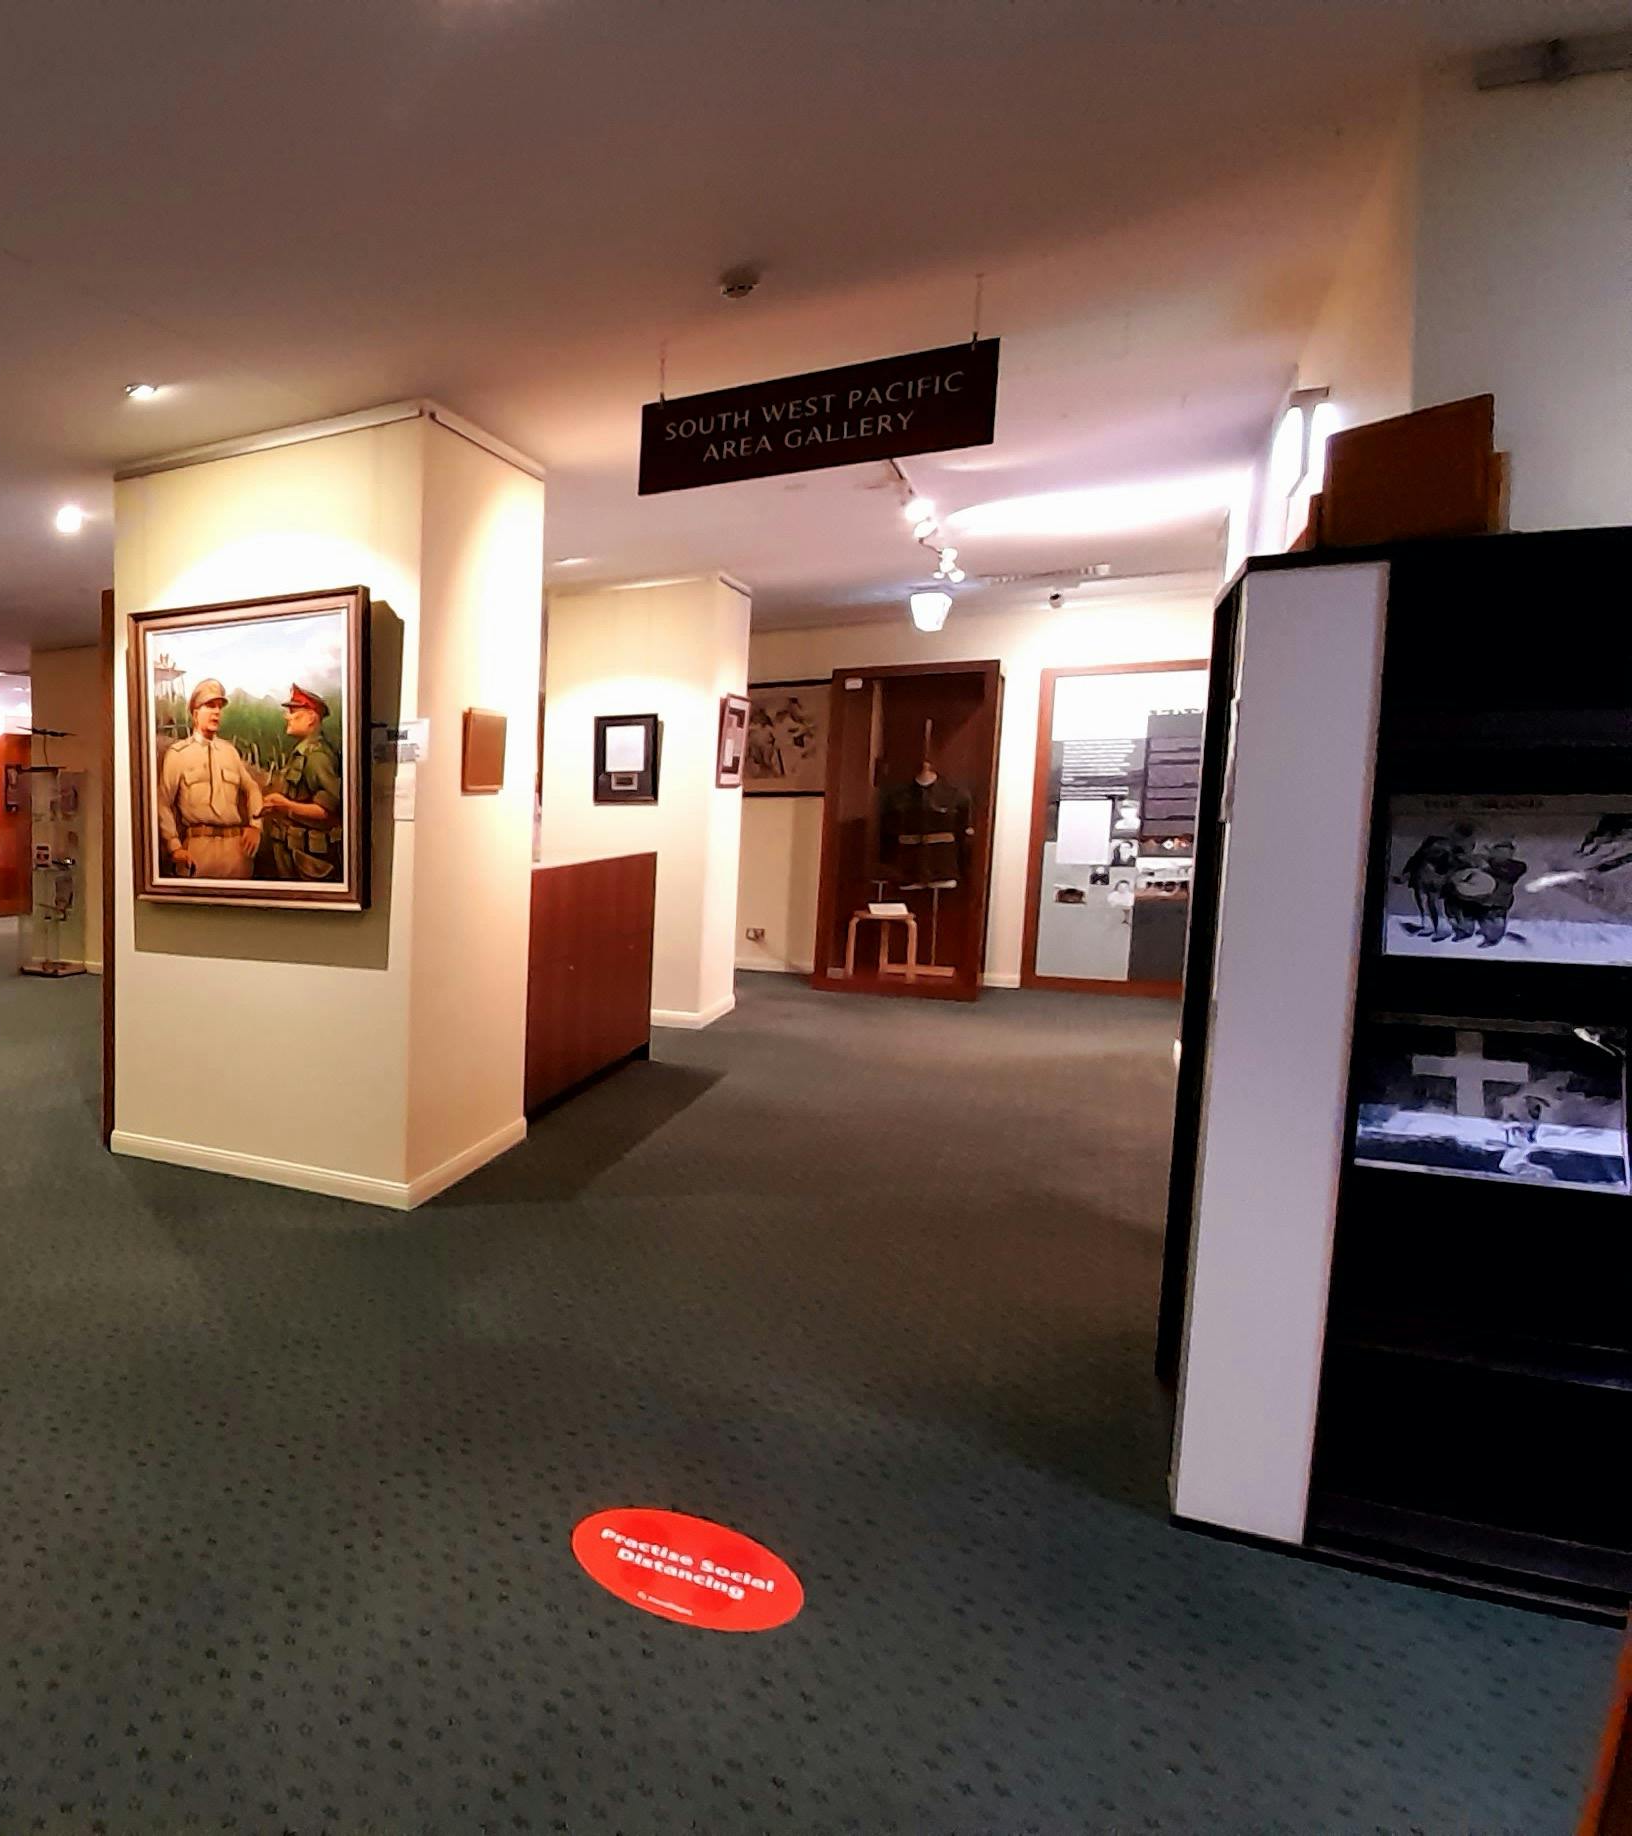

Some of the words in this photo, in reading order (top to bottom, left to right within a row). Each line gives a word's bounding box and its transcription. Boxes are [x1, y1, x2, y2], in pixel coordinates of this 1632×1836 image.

[665, 410, 750, 441] SOUTH
[762, 394, 835, 423] WEST
[848, 371, 964, 410] PACIFIC
[703, 435, 773, 463] AREA
[784, 410, 915, 449] GALLERY
[617, 1547, 746, 1601] Distancing
[700, 1558, 776, 1593] Social
